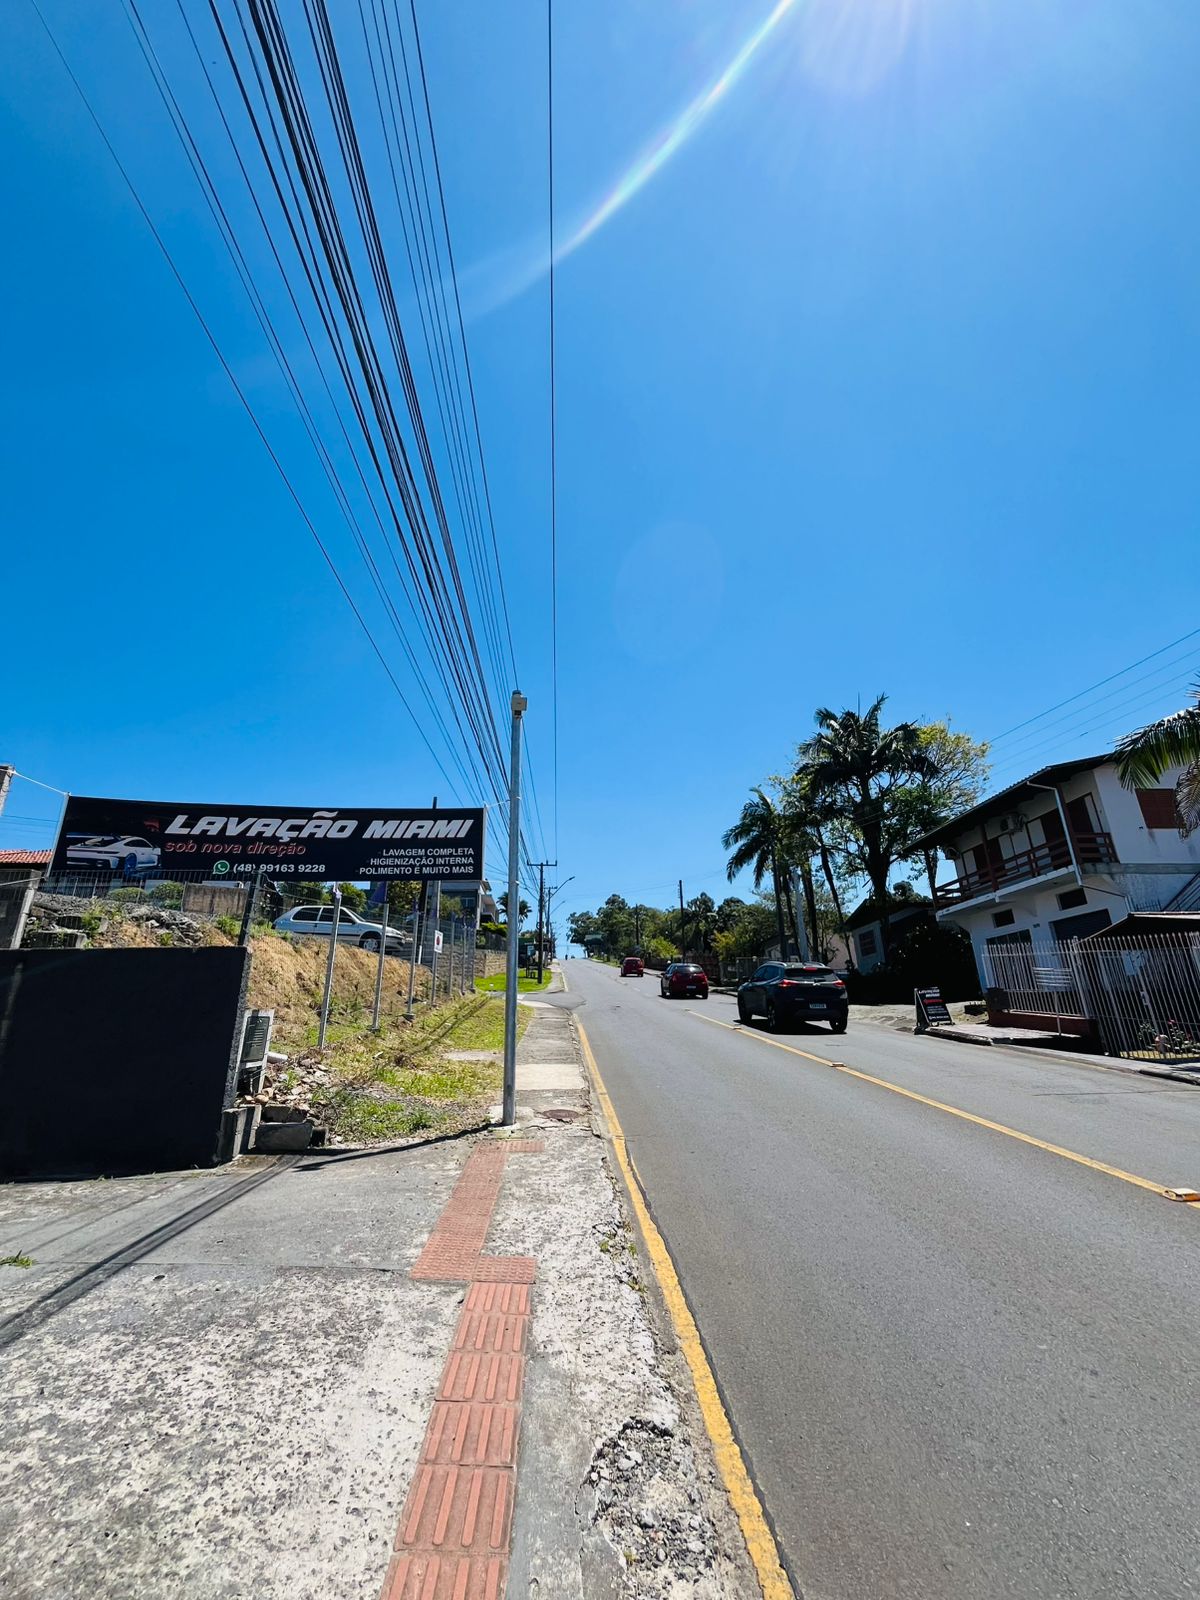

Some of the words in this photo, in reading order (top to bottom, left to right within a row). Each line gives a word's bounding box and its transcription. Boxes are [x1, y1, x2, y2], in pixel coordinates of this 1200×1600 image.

[164, 811, 359, 842] LAVAÇÃO
[362, 819, 474, 839] MIAMI
[164, 840, 197, 853] sob
[201, 842, 242, 854] nova
[247, 842, 306, 857] direção
[383, 848, 426, 856] LAVAGEM
[427, 847, 474, 856] COMPLETA
[370, 856, 434, 866] HIGIENIZAÇÃO
[435, 857, 474, 865] INTERNA
[233, 863, 256, 874] (48)
[259, 863, 295, 873] 99163
[298, 864, 326, 873] 9228
[359, 867, 412, 875] POLIMENTO
[422, 866, 451, 875] MUITO
[452, 866, 474, 874] MAIS
